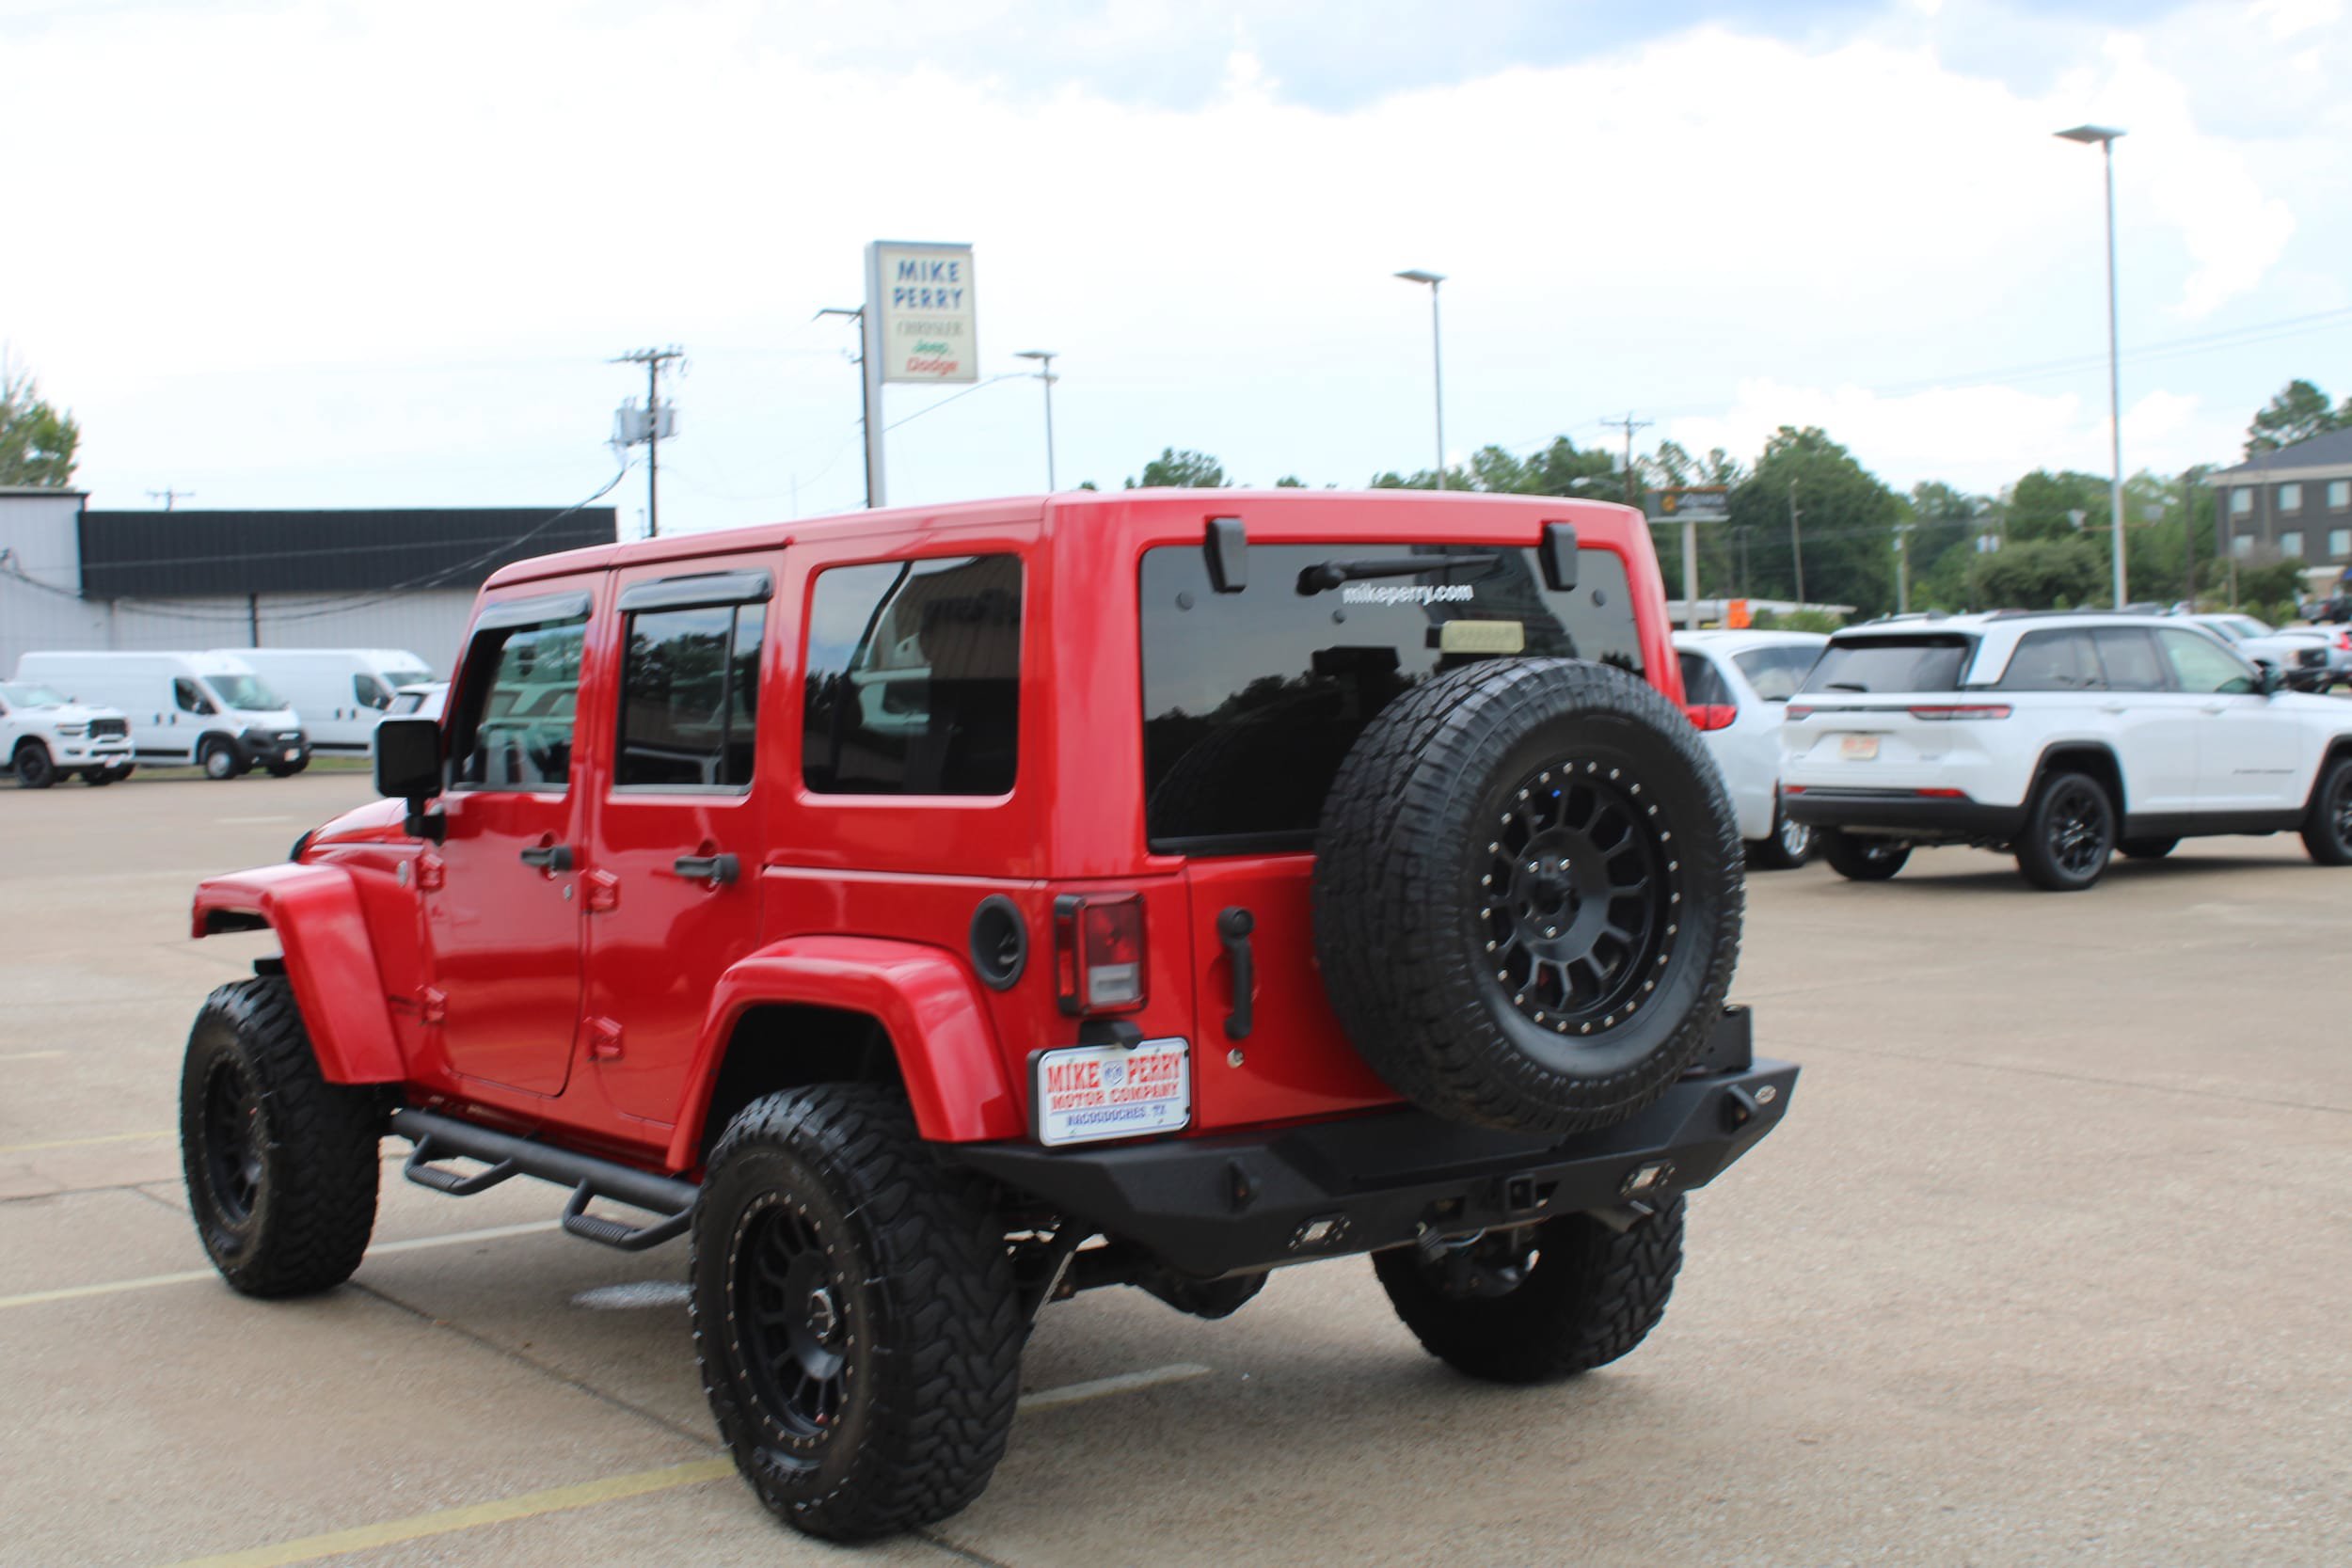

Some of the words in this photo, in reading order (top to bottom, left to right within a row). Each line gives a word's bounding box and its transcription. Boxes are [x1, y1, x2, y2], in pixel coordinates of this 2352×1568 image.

[897, 260, 961, 282] MIKE
[894, 286, 964, 309] PERRY
[906, 355, 959, 376] Dodge
[1343, 583, 1474, 606] mikeperry.com
[1046, 1060, 1102, 1093] MIKE
[1127, 1052, 1183, 1085] PERRY
[1051, 1089, 1105, 1111] MOTOR
[1110, 1082, 1179, 1103] COMPANY
